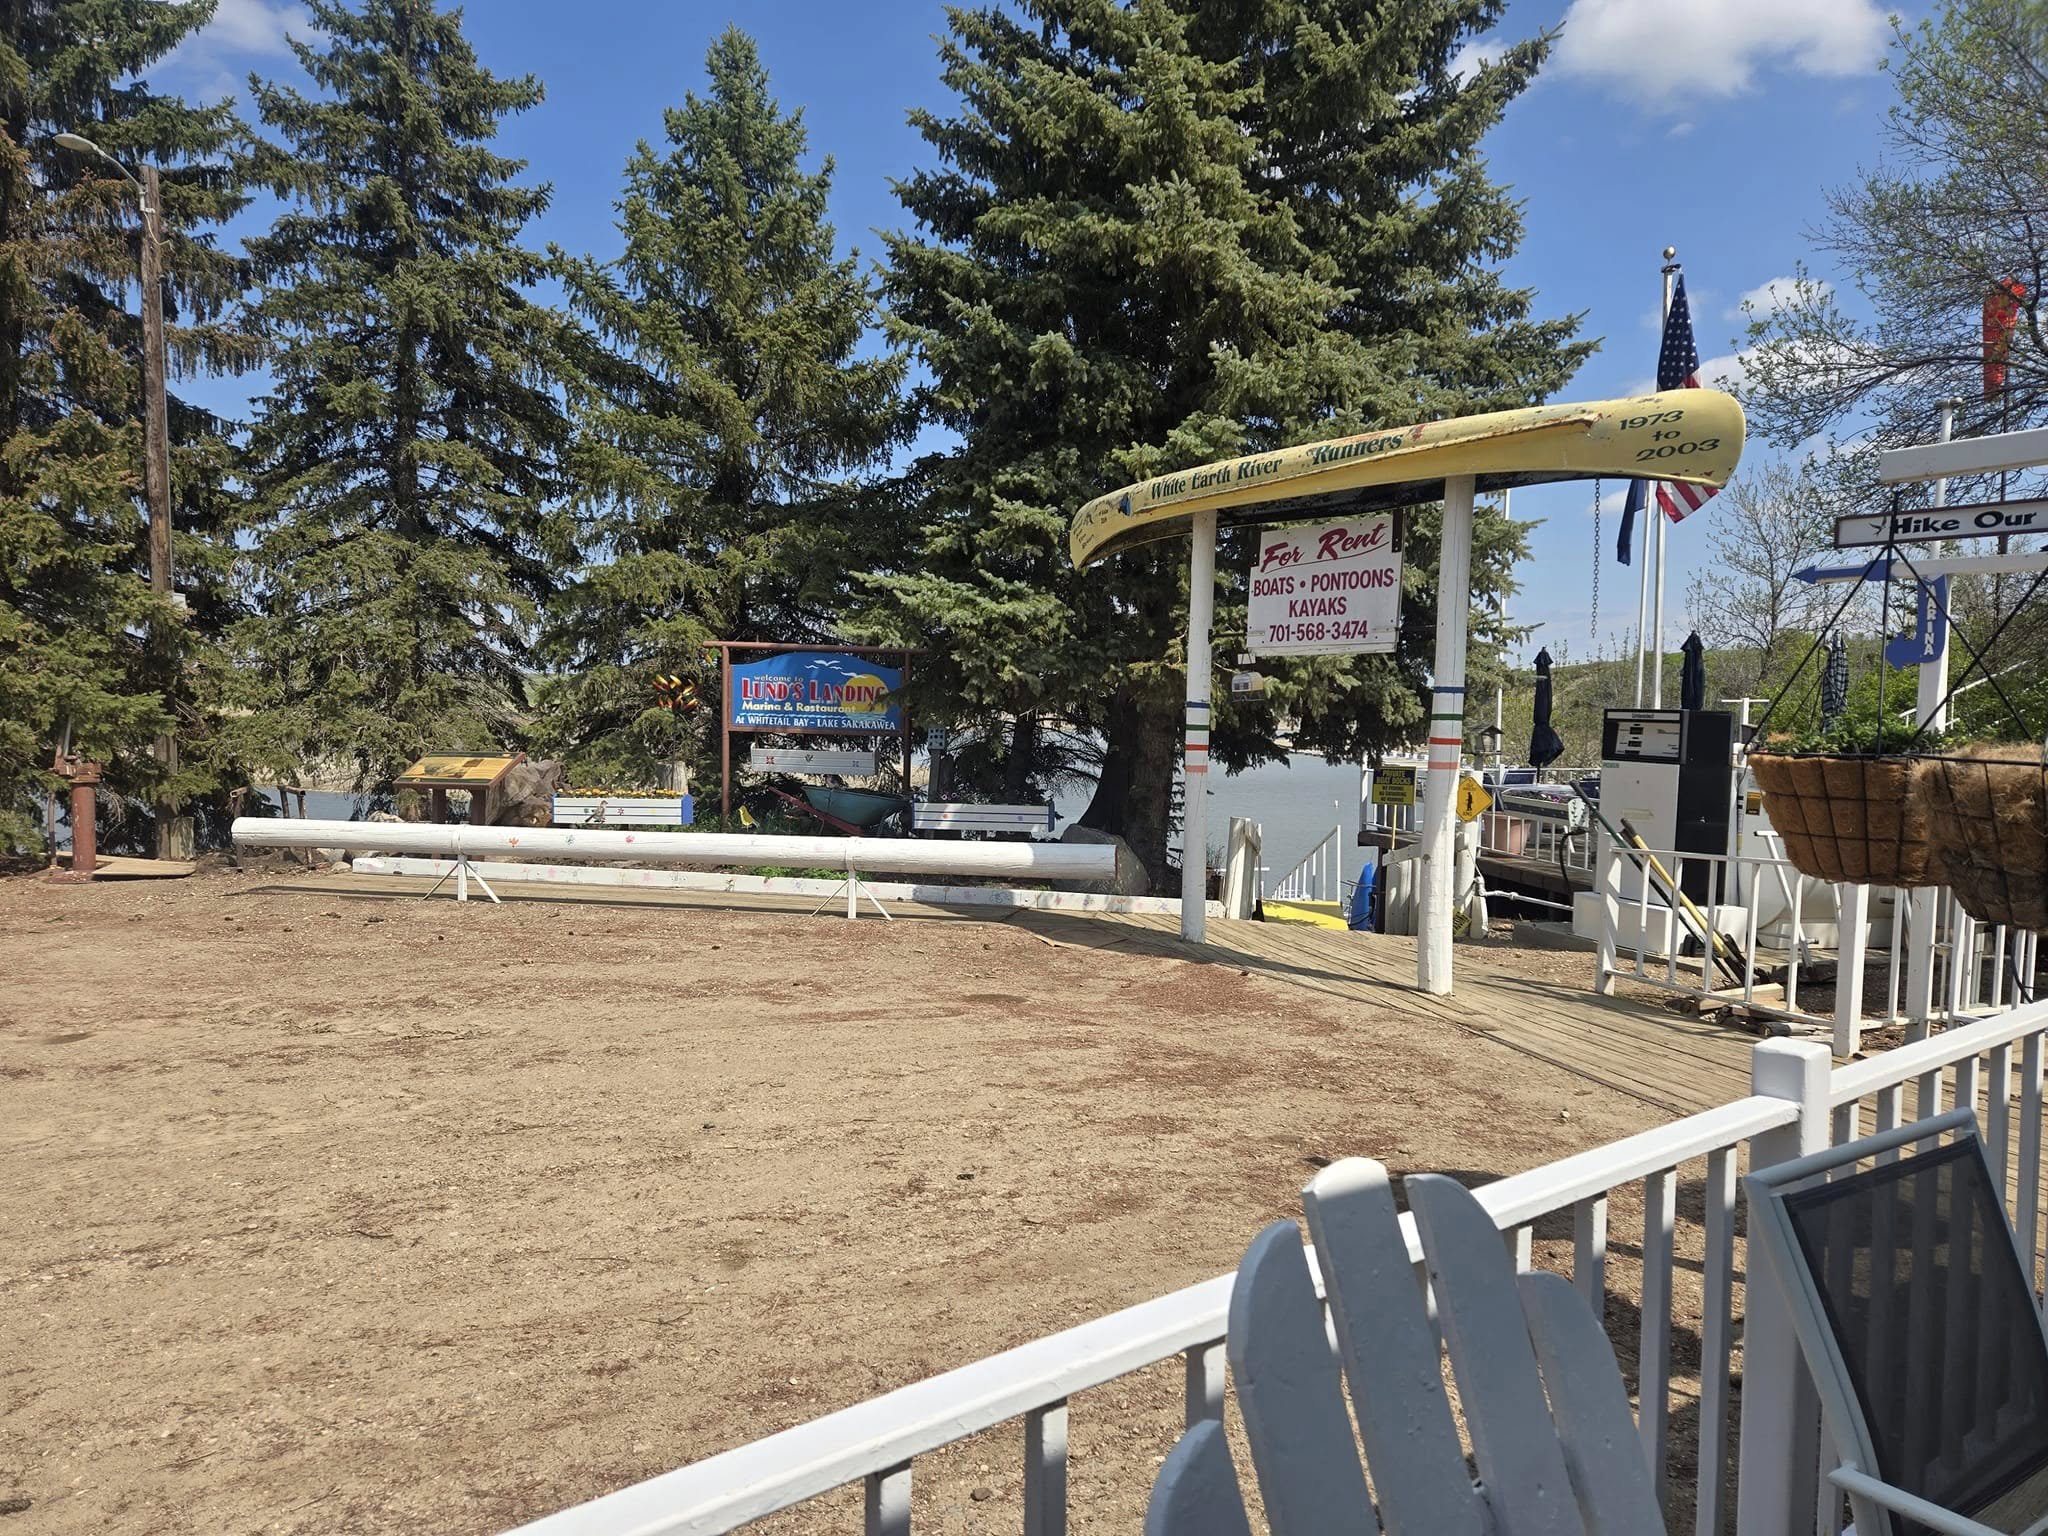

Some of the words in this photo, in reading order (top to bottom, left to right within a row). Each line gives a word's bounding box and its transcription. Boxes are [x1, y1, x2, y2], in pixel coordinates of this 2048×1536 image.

[1620, 410, 1684, 430] 1973
[1651, 430, 1681, 441] to
[1635, 438, 1720, 462] 2003
[1151, 478, 1186, 500] White
[1191, 466, 1231, 490] Earth
[1237, 456, 1283, 480] River
[1308, 433, 1404, 466] Runners
[1894, 516, 1961, 535] Hike
[1974, 510, 2037, 529] Our
[1260, 541, 1304, 573] For
[1316, 523, 1388, 560] Rent
[1253, 576, 1295, 597] BOATS
[1310, 567, 1395, 593] PONTOONS
[1288, 596, 1348, 618] KAYAKS
[1269, 620, 1368, 643] 701-568-3474
[1923, 584, 1937, 656] MARINA
[741, 700, 781, 711] Marina
[784, 702, 793, 711] &
[748, 715, 792, 726] WHITETAIL
[793, 717, 809, 727] BAY
[817, 718, 839, 728] LAKE
[841, 718, 896, 730] SAKAKAWEA
